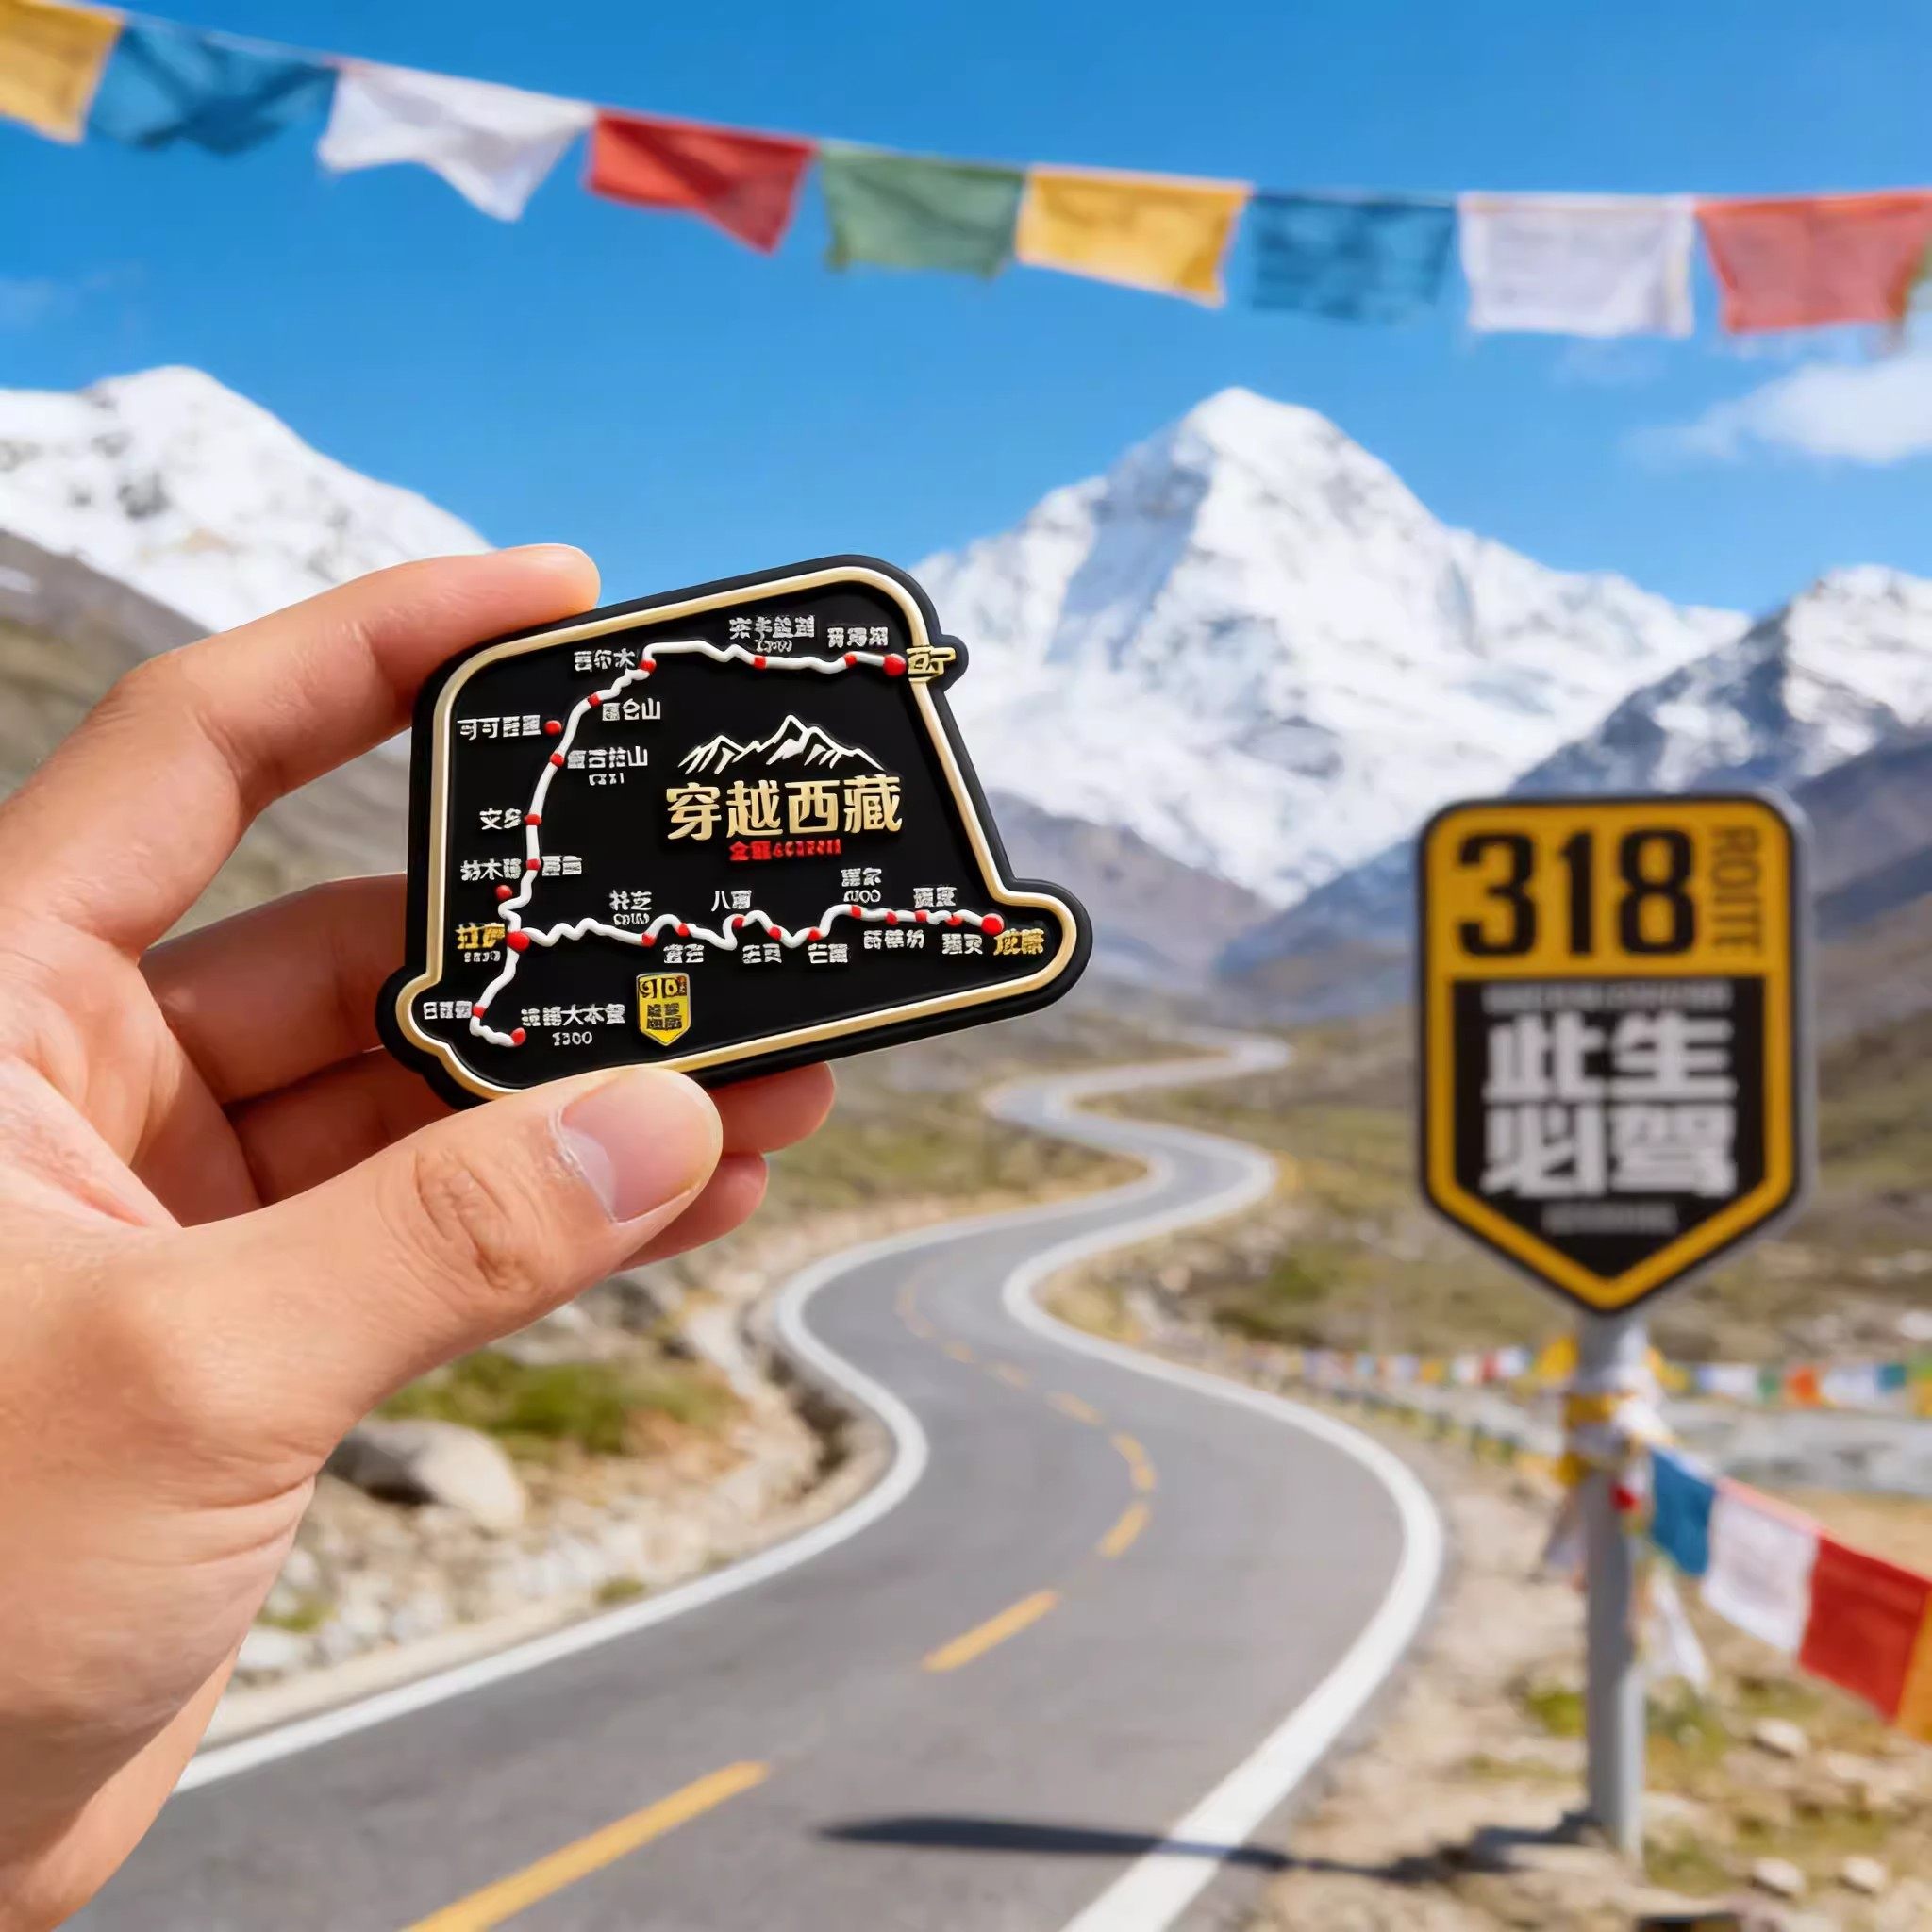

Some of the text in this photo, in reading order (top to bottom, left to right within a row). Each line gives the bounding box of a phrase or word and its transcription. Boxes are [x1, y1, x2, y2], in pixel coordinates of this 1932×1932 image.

[666, 774, 903, 841] 穿越西藏
[1457, 828, 1695, 958] 318
[1483, 1012, 1738, 1102] 此生
